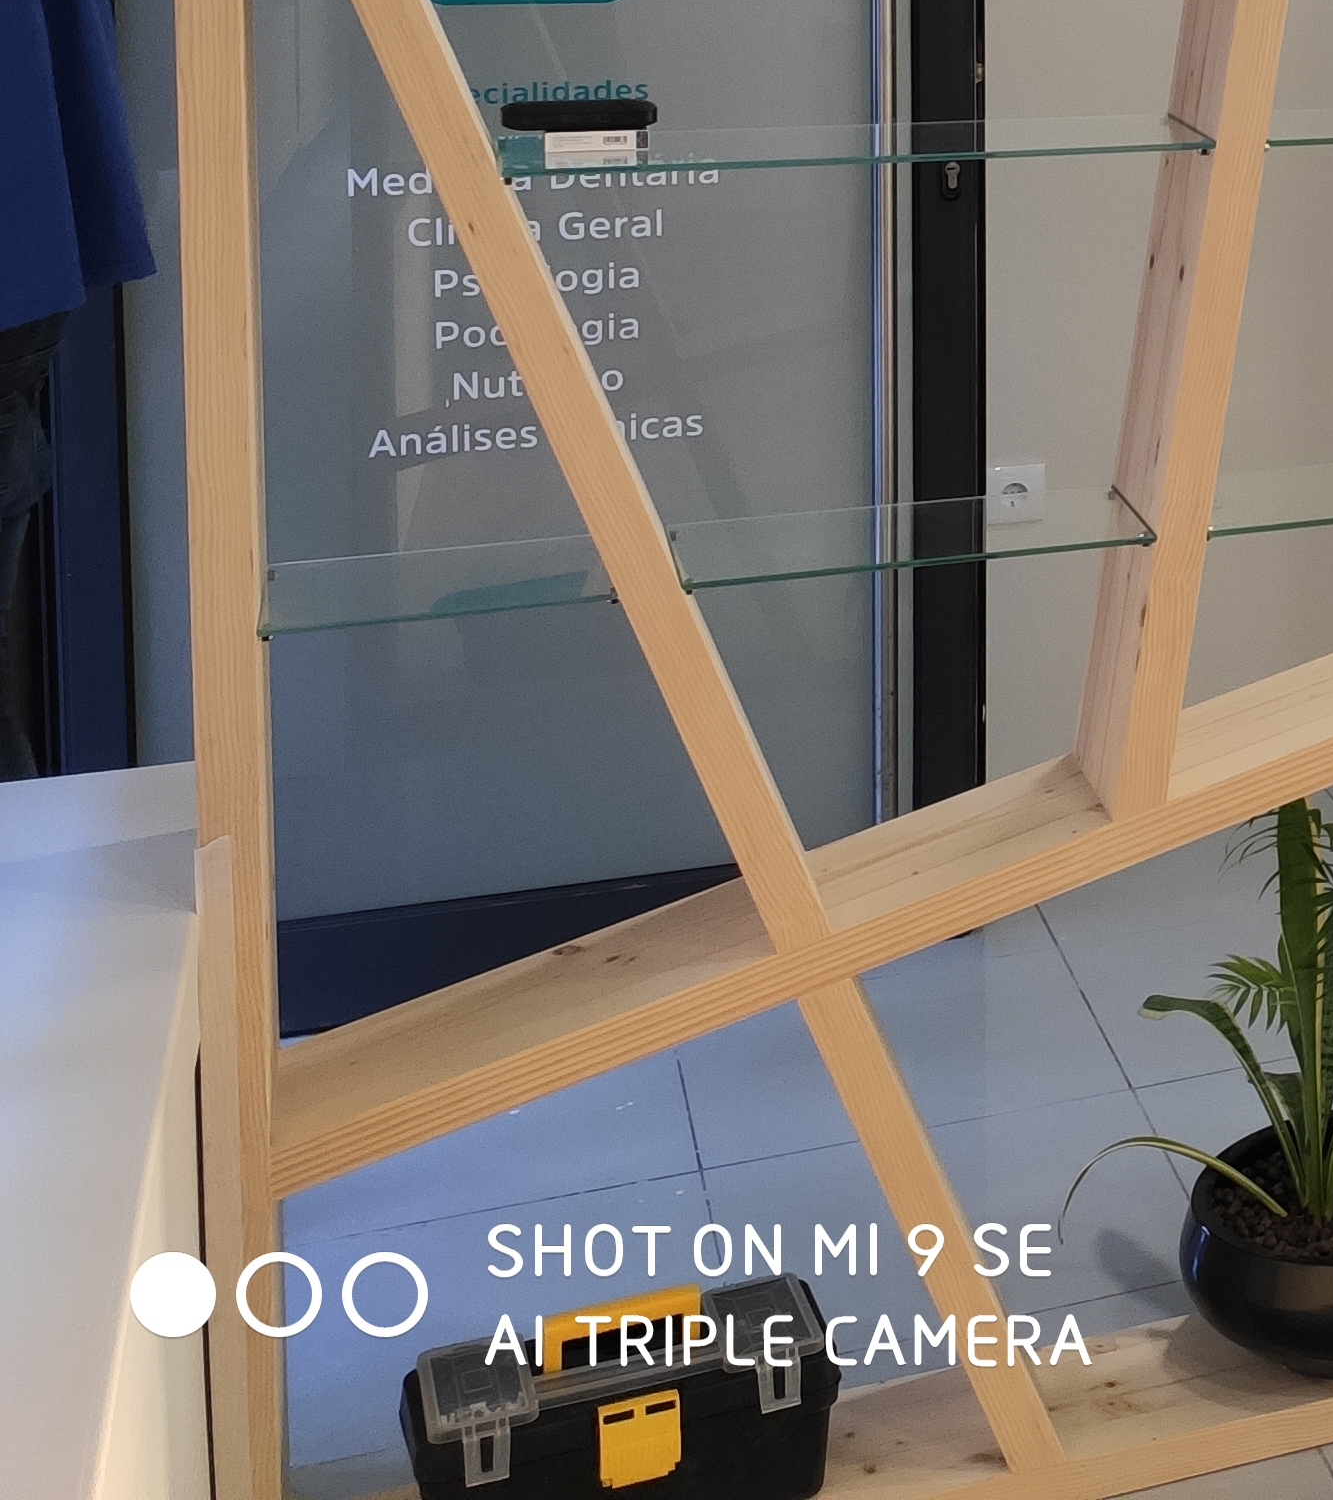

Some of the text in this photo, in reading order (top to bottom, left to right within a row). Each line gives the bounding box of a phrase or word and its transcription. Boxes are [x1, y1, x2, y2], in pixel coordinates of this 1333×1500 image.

[472, 79, 649, 104] ecialidades
[559, 209, 663, 240] Geral
[434, 262, 640, 298] Psogia
[453, 369, 624, 401] Nuto
[368, 425, 539, 459] Análises
